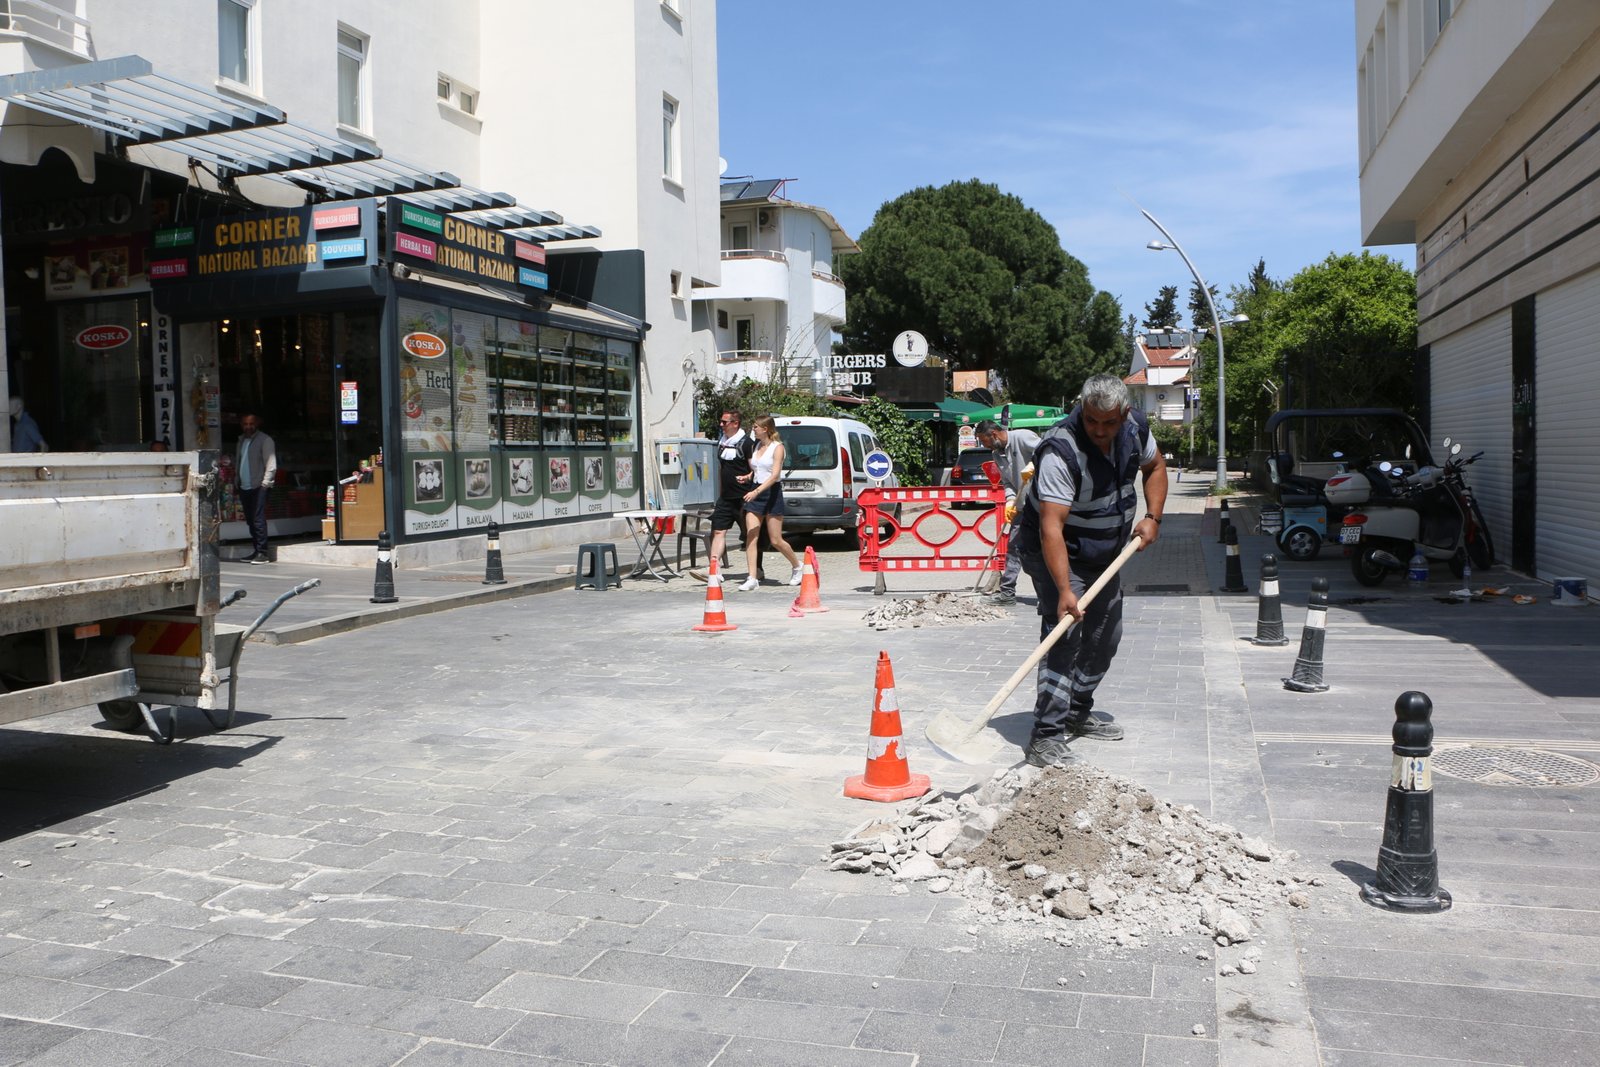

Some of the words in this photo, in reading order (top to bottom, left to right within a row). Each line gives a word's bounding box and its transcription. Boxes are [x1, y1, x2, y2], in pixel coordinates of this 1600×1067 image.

[338, 213, 357, 223] COFFEE
[404, 210, 424, 223] TURKISH
[424, 216, 441, 229] DELIGHT
[215, 215, 301, 247] CORNER
[444, 217, 505, 255] CORNER
[321, 243, 362, 255] SOUVENIR
[400, 238, 421, 253] HERBAL
[422, 244, 432, 256] TEA
[198, 246, 258, 275] NATURAL
[262, 243, 317, 269] BAZAAR
[432, 244, 476, 274] ATURAL
[478, 255, 515, 284] BAZAAR
[152, 264, 174, 275] HERBAL
[174, 263, 186, 273] TEA
[82, 331, 126, 343] KOSKA
[158, 316, 169, 378] ORNER
[408, 339, 442, 351] KOSKA
[821, 354, 887, 369] URGERS
[160, 398, 171, 447] BAZA
[554, 506, 569, 516] SPICE
[588, 503, 603, 512] COFFE
[620, 501, 630, 510] TEA
[466, 514, 493, 526] BAKLAVA
[512, 510, 534, 521] HALVAH
[412, 520, 431, 531] TURKISH
[431, 518, 449, 530] DELIGHT
